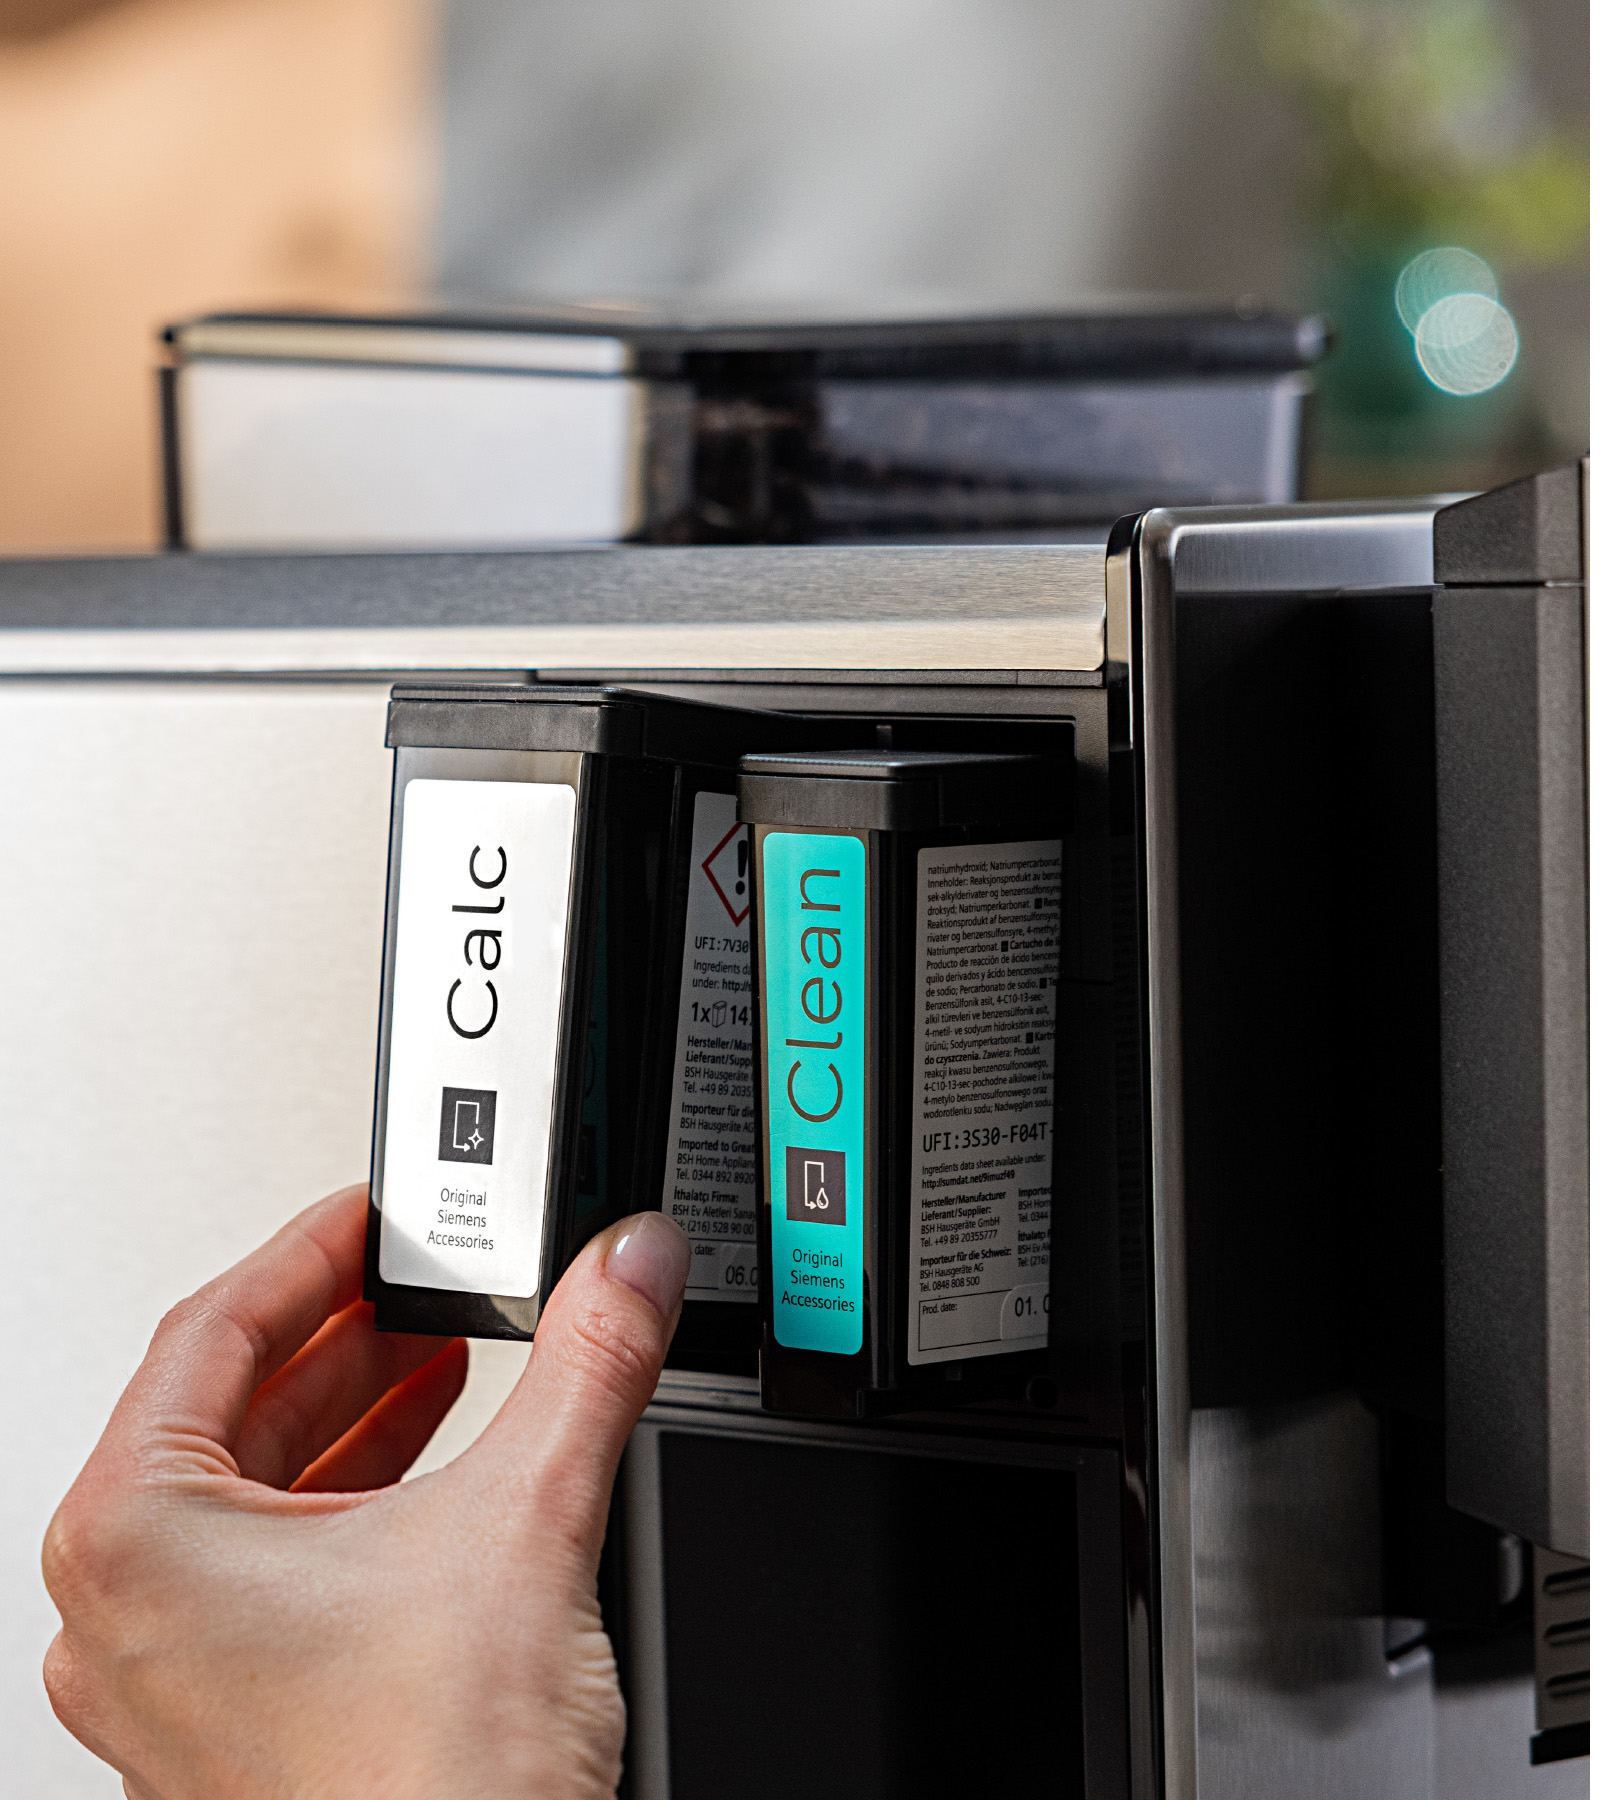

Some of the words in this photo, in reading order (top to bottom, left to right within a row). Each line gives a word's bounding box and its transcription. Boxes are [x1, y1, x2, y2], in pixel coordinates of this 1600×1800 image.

[446, 844, 507, 1040] Calc
[695, 936, 749, 953] UFI:7V30
[693, 960, 740, 974] Ingredients
[692, 977, 719, 988] under:
[786, 868, 843, 1123] Clean
[729, 1005, 752, 1026] 14
[684, 1066, 701, 1077] BSH
[703, 1068, 749, 1083] Hausgeräte
[730, 1084, 754, 1098] 2035
[681, 1102, 725, 1116] Importeur
[727, 1104, 740, 1117] für
[741, 1105, 754, 1118] die
[680, 1117, 696, 1129] BSH
[697, 1119, 741, 1133] Hausgeräte
[742, 1121, 754, 1132] AG
[678, 1138, 719, 1152] Imported
[720, 1141, 729, 1152] to
[731, 1140, 755, 1153] Great
[922, 1163, 958, 1176] Ingredients
[960, 1161, 975, 1170] data
[976, 1159, 994, 1169] sheet
[995, 1155, 1024, 1166] available
[1024, 1153, 1046, 1163] under:
[676, 1168, 689, 1180] Tel.
[692, 1169, 713, 1181] 0344
[715, 1170, 732, 1183] 892
[733, 1172, 755, 1184] 8920
[440, 1187, 487, 1208] Original
[921, 1192, 1006, 1208] Hersteller/Manufacturer
[437, 1209, 487, 1228] Siemens
[921, 1206, 991, 1221] Lieferant/Supplier:
[687, 1220, 710, 1233] (216)
[712, 1221, 729, 1233] 528
[730, 1221, 742, 1233] 90
[743, 1223, 754, 1235] 00
[921, 1224, 935, 1234] BSH
[936, 1220, 976, 1232] Hausgeräte
[977, 1216, 1000, 1227] GmbH
[427, 1230, 494, 1251] Accessories
[920, 1237, 933, 1247] Tel.
[934, 1235, 948, 1245] +49
[949, 1234, 959, 1244] 89
[961, 1229, 997, 1242] 20355777
[792, 1248, 843, 1268] Original
[920, 1255, 956, 1267] Importeur
[956, 1251, 967, 1261] für
[968, 1250, 980, 1260] die
[981, 1247, 1011, 1258] Schweiz:
[919, 1269, 933, 1279] BSH
[934, 1265, 972, 1278] Hausgeräte
[973, 1262, 984, 1272] AG
[790, 1269, 845, 1290] Siemens
[919, 1282, 931, 1292] Tel.
[932, 1279, 950, 1290] 0848
[951, 1277, 965, 1288] 808
[966, 1276, 980, 1286] 500
[781, 1290, 855, 1313] Accessories
[922, 1304, 939, 1314] Prod.
[940, 1303, 957, 1312] date:
[1014, 1296, 1037, 1317] 01.
